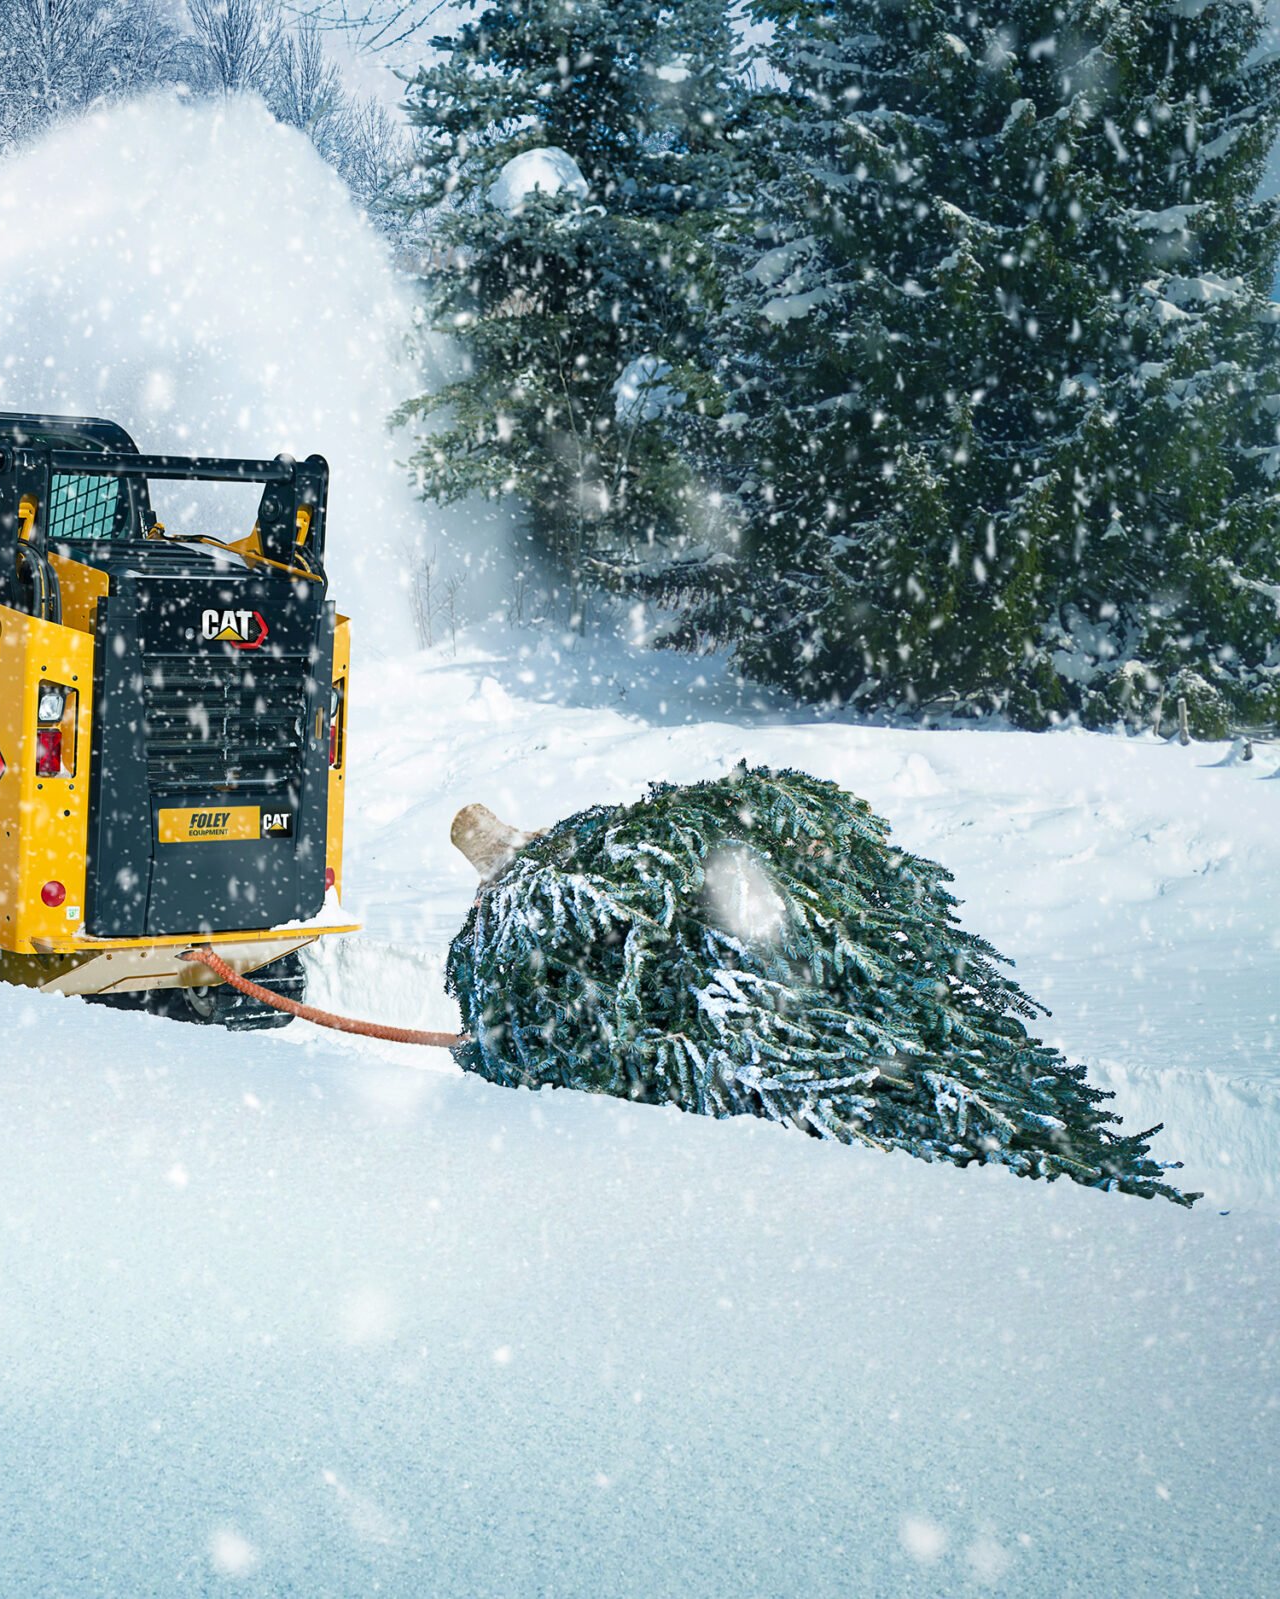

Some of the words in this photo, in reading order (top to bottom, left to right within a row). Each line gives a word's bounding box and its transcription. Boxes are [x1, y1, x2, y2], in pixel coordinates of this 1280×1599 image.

[202, 609, 253, 640] CAT
[189, 812, 230, 828] FOLEY
[263, 813, 290, 830] CAT
[188, 828, 228, 837] EQUIPMENT
